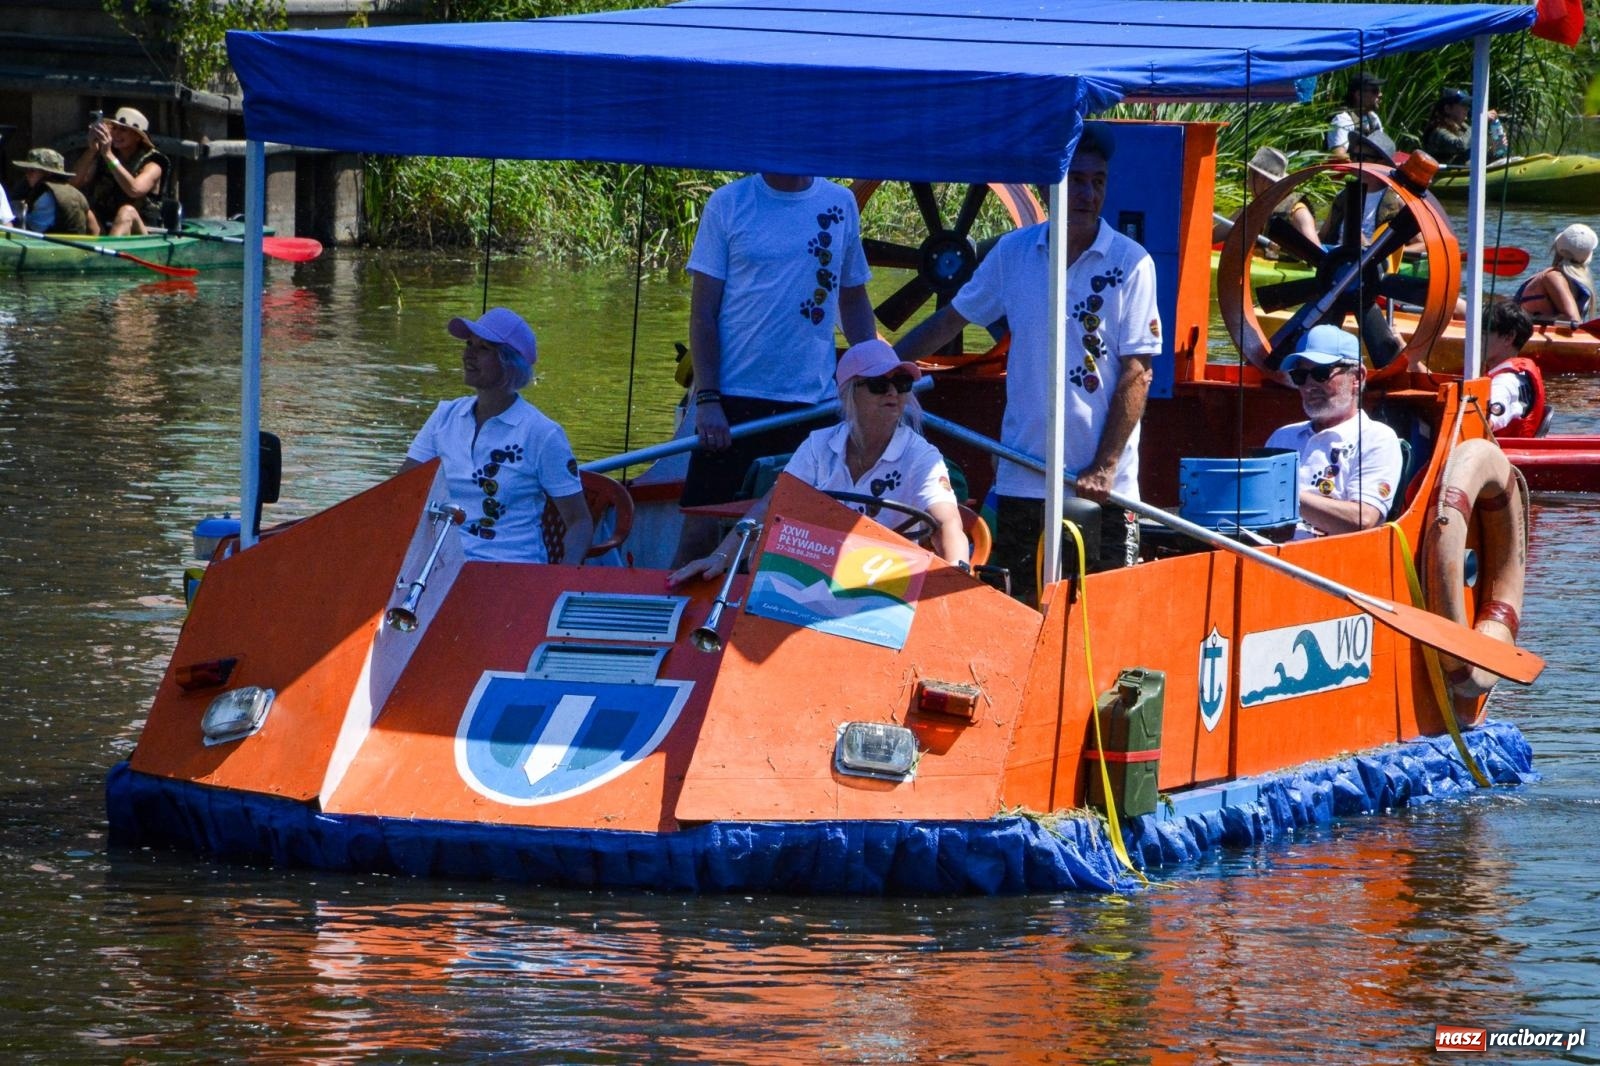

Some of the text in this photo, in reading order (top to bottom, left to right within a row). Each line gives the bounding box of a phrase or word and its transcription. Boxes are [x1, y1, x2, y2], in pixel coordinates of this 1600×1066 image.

[781, 523, 809, 539] XXVII
[779, 534, 835, 556] PŁYWADŁA
[862, 554, 893, 586] 4
